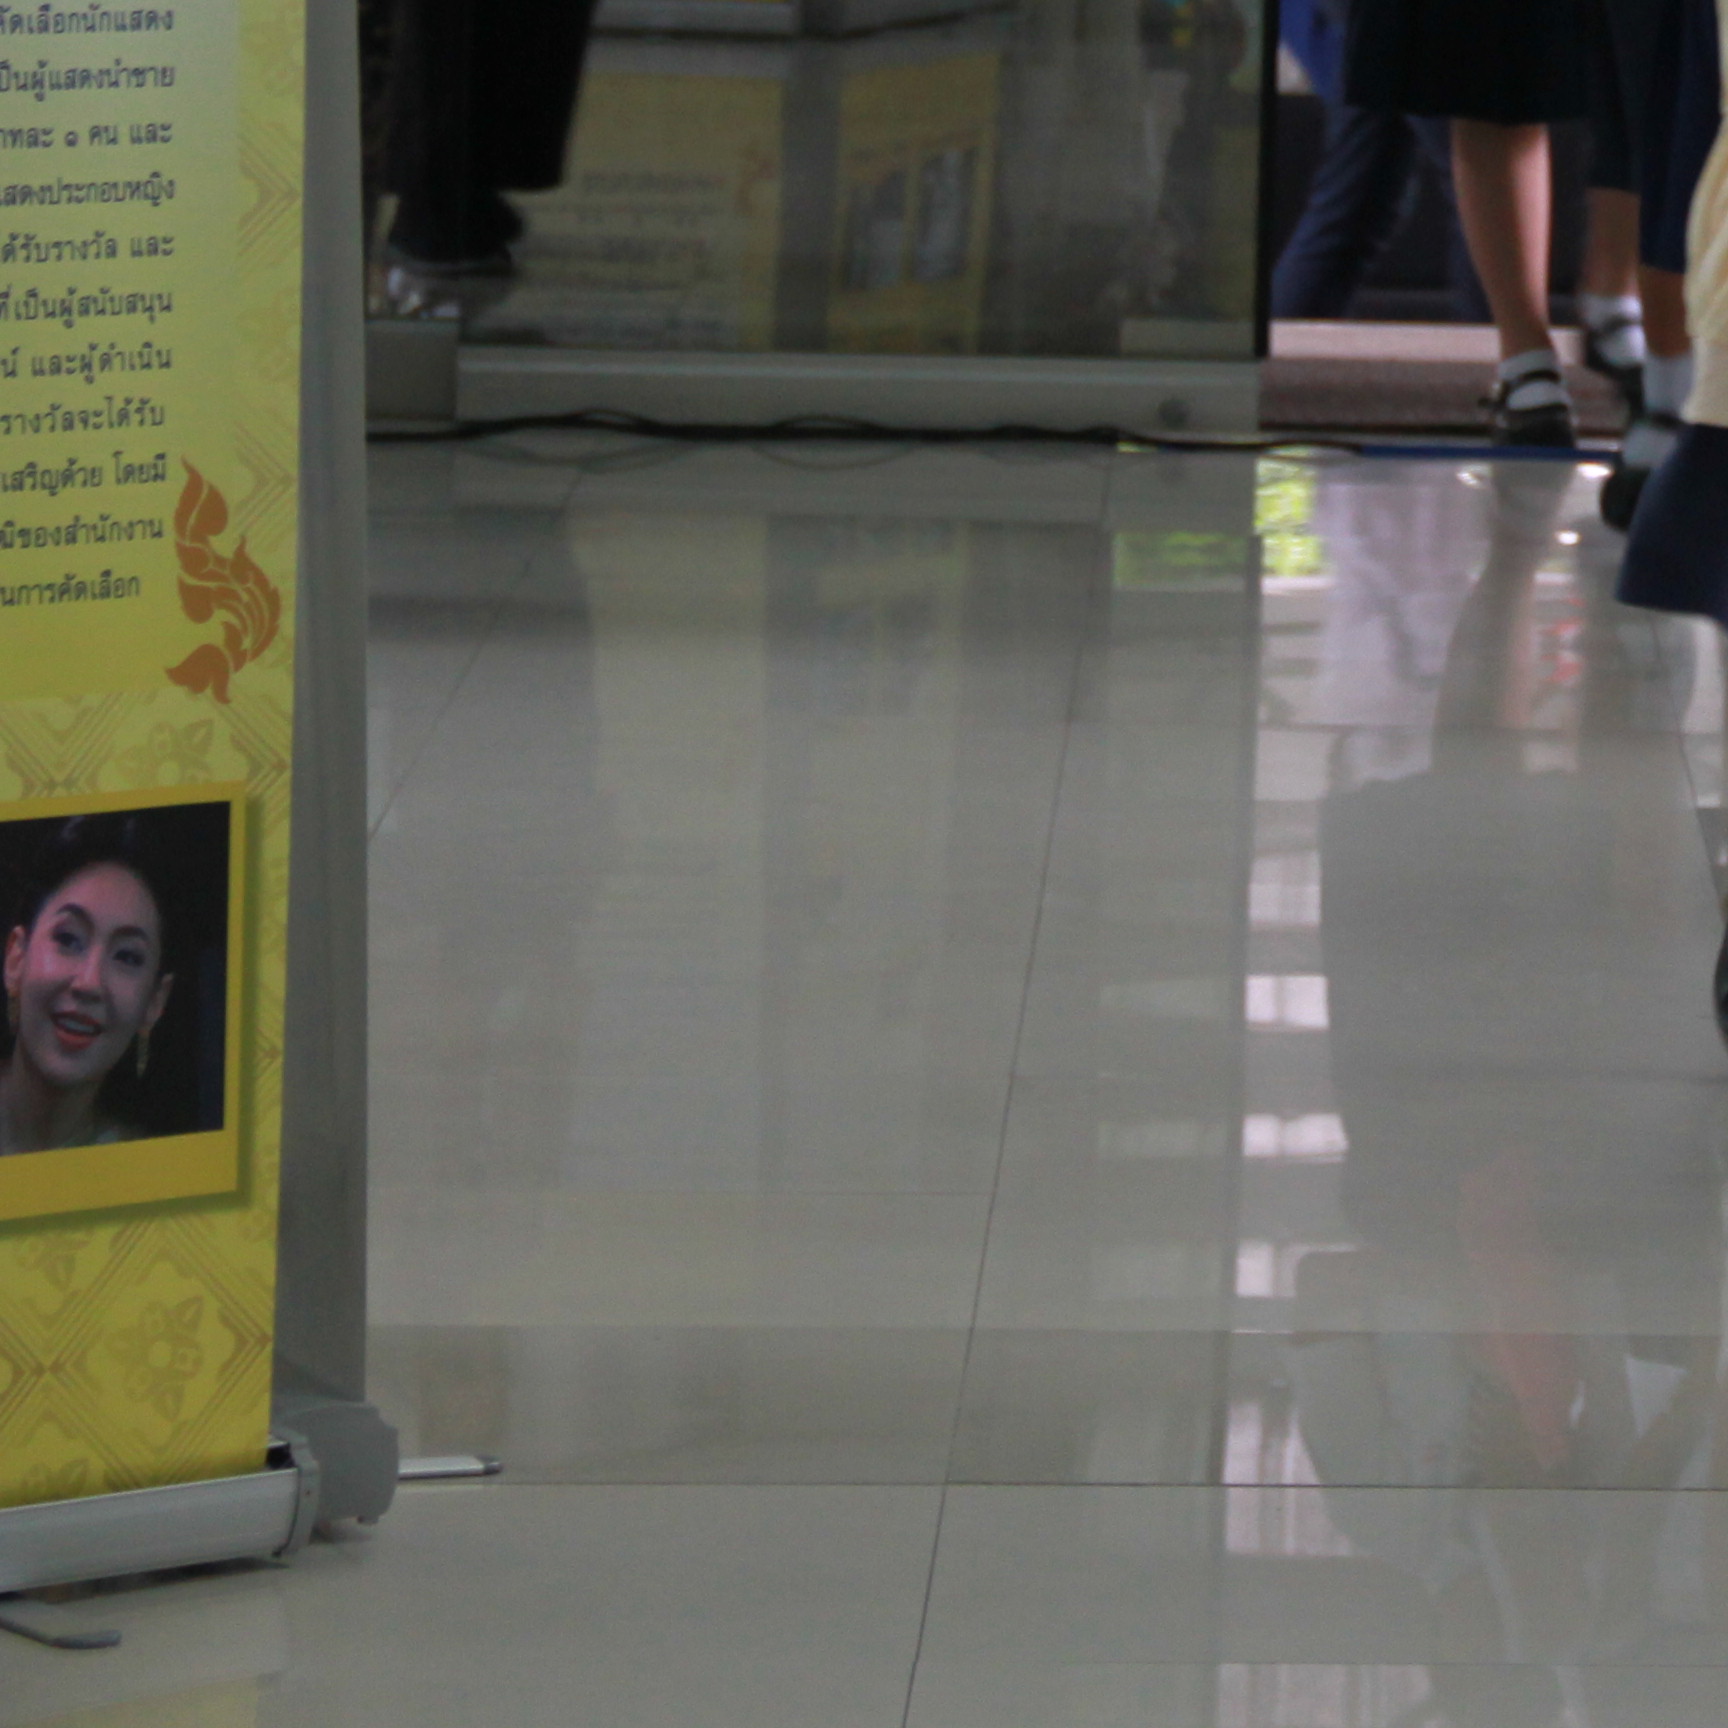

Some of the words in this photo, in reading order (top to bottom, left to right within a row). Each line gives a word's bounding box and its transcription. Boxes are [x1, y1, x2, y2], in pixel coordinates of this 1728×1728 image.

[89, 125, 118, 145] คน
[130, 123, 172, 144] และ
[0, 172, 175, 206] สดงประกอบหญิง
[130, 235, 174, 258] และ
[31, 342, 172, 384] และผู้ดำเนิน
[0, 396, 165, 434] รางวัลจะได้รับ
[112, 450, 168, 486] โดยมี
